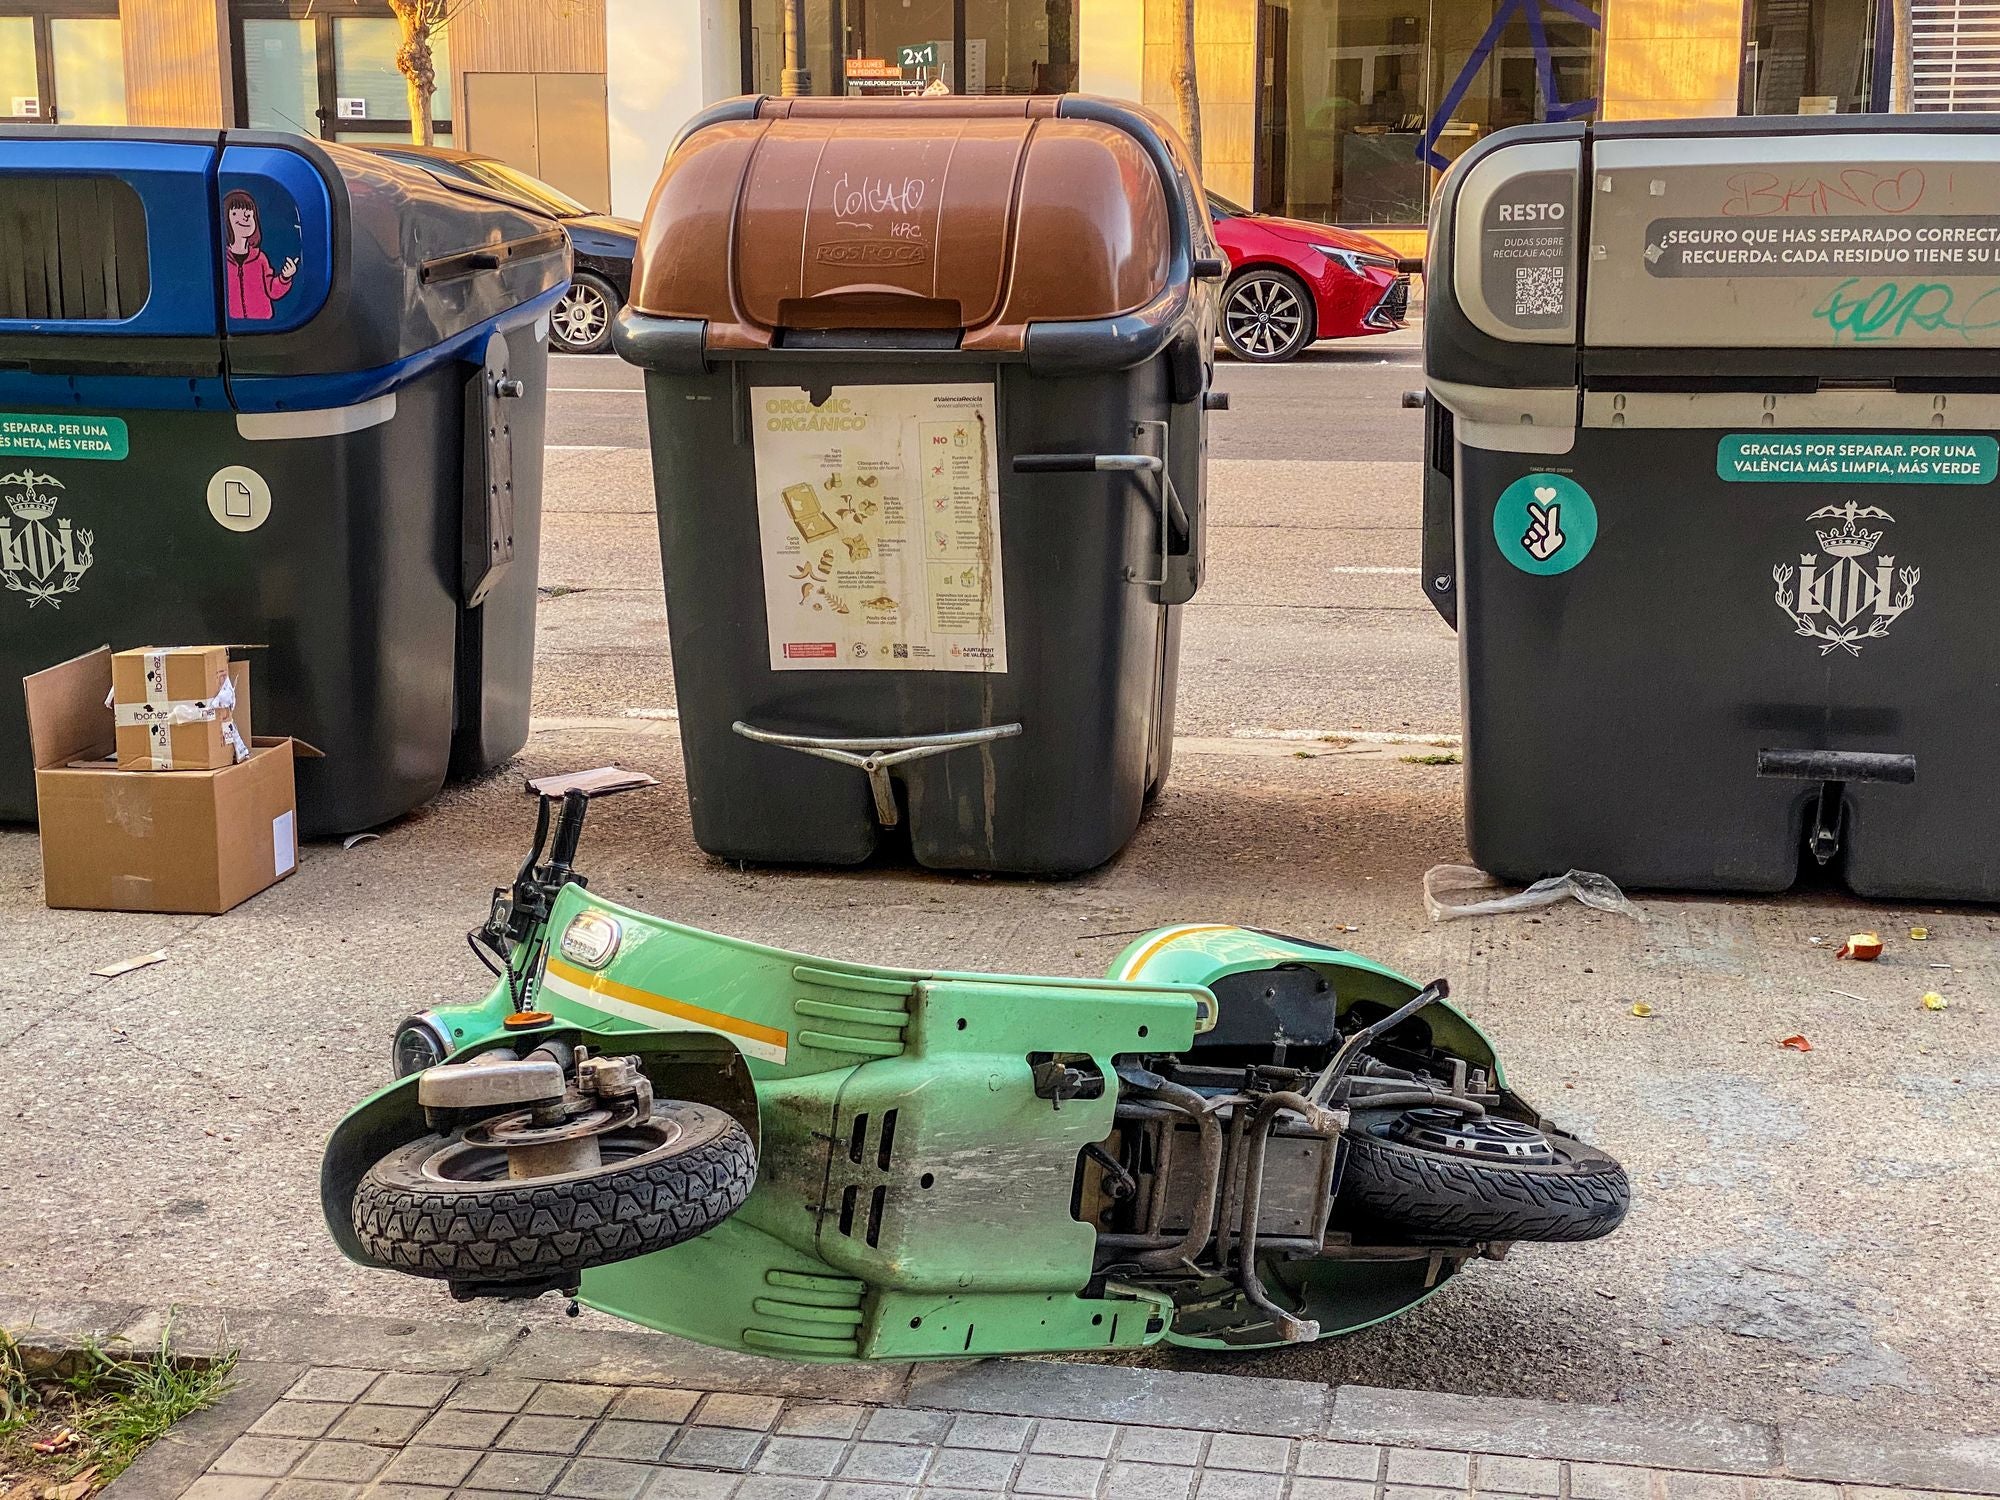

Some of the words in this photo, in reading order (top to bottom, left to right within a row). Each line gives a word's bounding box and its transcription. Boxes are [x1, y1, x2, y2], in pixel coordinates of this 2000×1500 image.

[902, 46, 933, 64] 2x1
[848, 61, 861, 69] LOS
[863, 61, 883, 69] LUNES
[1499, 203, 1565, 221] RESTO
[1504, 238, 1533, 247] DUDAS
[1535, 237, 1564, 246] SOBRE
[1660, 229, 1738, 249] ¿SEGURO
[1741, 229, 1778, 246] QUE
[1782, 229, 1817, 244] HAS
[1820, 228, 1912, 243] SEPARADO
[1493, 249, 1538, 258] RECICLAJE
[1682, 249, 1777, 264] RECUERDA:
[1781, 249, 1829, 263] CADA
[1833, 248, 1910, 263] RESIDUO
[1913, 248, 1963, 262] TIENE
[1967, 248, 1990, 262] SU
[3, 422, 57, 434] SEPARAR.
[59, 424, 80, 435] PER
[82, 425, 108, 436] UNA
[766, 413, 866, 432] ORGÁNICO
[13, 437, 46, 451] NETA,
[48, 436, 71, 449] MÉS
[73, 440, 112, 451] VERDA
[932, 436, 948, 444] NO
[1740, 444, 1802, 456] GRACIAS
[1805, 444, 1835, 456] POR
[1839, 444, 1907, 457] SEPARAR.
[1910, 445, 1940, 457] POR
[1944, 445, 1977, 457] UNA
[1734, 457, 1804, 472] VALÈNCIA
[1807, 458, 1838, 472] MÁS
[1841, 461, 1894, 476] LIMPIA,
[1897, 459, 1929, 474] MÁS
[1932, 462, 1981, 474] VERDE
